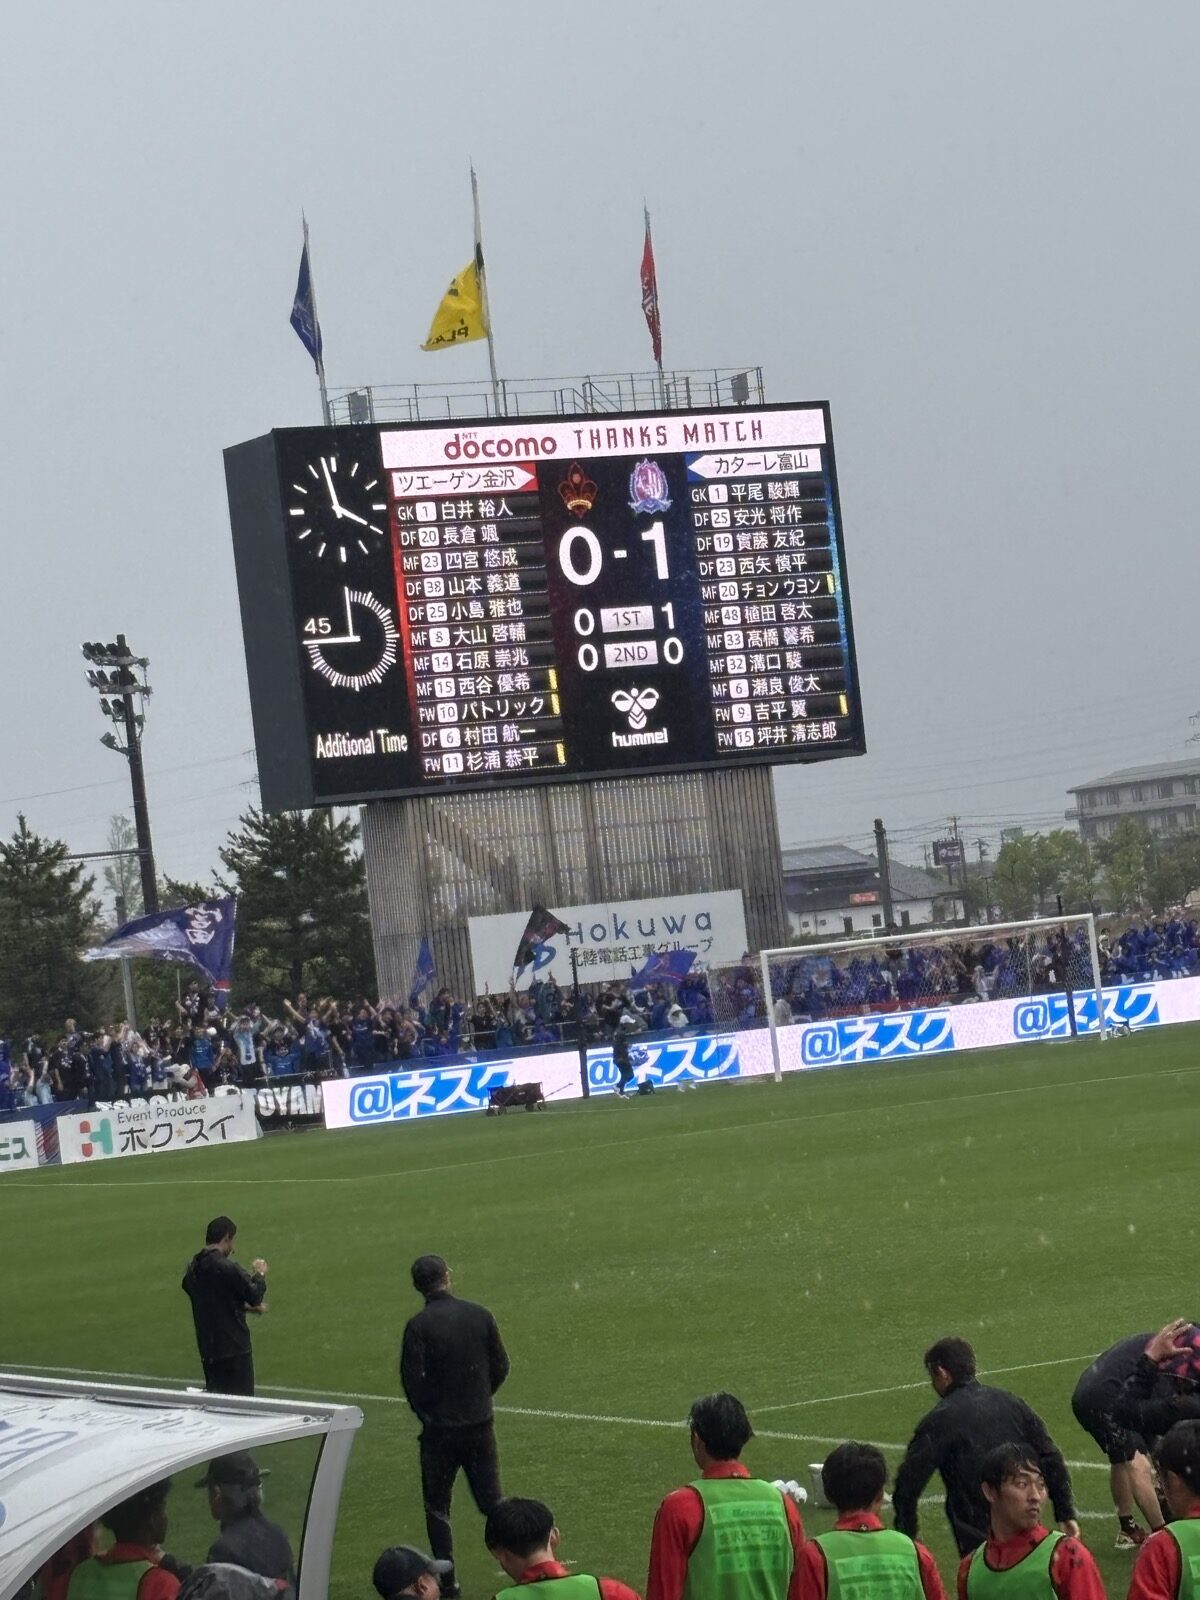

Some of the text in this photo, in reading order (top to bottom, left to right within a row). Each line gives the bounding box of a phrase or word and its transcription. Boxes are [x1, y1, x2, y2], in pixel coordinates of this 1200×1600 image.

[444, 420, 763, 460] docomo THANKS MATCH
[714, 452, 809, 474] カターレ富山
[399, 469, 516, 492] ツエーゲン金沢
[691, 489, 708, 502] GK
[731, 483, 764, 502] 平尾
[398, 507, 414, 521] GK
[442, 500, 474, 519] 白井
[694, 505, 802, 527] DF 25 安光 将作
[401, 532, 416, 545] DF
[422, 531, 436, 542] 20
[443, 525, 476, 545] 長倉
[697, 537, 712, 551] DF
[716, 536, 730, 548] 19
[772, 529, 805, 548] 友紀
[403, 557, 419, 571] MF
[424, 556, 439, 568] 23
[445, 551, 479, 570] 四宮
[558, 526, 602, 586] 0
[641, 521, 669, 580] 1
[700, 562, 714, 576] DF
[719, 561, 733, 572] 23
[738, 556, 772, 574] 西矢
[406, 583, 421, 596] DF
[427, 581, 441, 593] 38
[449, 576, 482, 595] 山本
[702, 578, 820, 599] MF 20 チョン ウヨン
[409, 607, 424, 621] DF
[430, 606, 444, 618] 25
[451, 601, 484, 620] 小島
[574, 602, 675, 636] 0 1ST 1
[704, 610, 720, 624] MF
[724, 609, 738, 621] 48
[780, 602, 813, 621] 啓太
[304, 618, 332, 634] 45
[411, 632, 427, 646] MF
[453, 625, 487, 645] 大山
[707, 635, 722, 648] MF
[727, 634, 741, 645] 33
[414, 658, 429, 671] MF
[436, 656, 449, 668] 14
[456, 650, 490, 670] 石原
[578, 637, 684, 672] 0 2ND 0
[709, 659, 724, 673] MF
[729, 658, 743, 670] 32
[416, 683, 432, 696] MF
[438, 681, 452, 693] 15
[458, 675, 493, 695] 西谷
[712, 684, 727, 698] MF
[788, 674, 821, 693] 俊太
[419, 697, 544, 722] FW 10 パトリック
[715, 708, 731, 722] FW
[754, 701, 787, 721] 吉平
[316, 728, 408, 759] Additional Time
[423, 733, 437, 746] DF
[464, 726, 498, 746] 村田
[612, 728, 669, 747] hummel
[717, 721, 837, 747] FW 15 坪井 清志郎
[425, 758, 441, 772] FW
[448, 757, 459, 768] 11
[565, 911, 712, 946] Hokuwa
[802, 1010, 955, 1065] @ネスク
[117, 1103, 207, 1124] Event Produce
